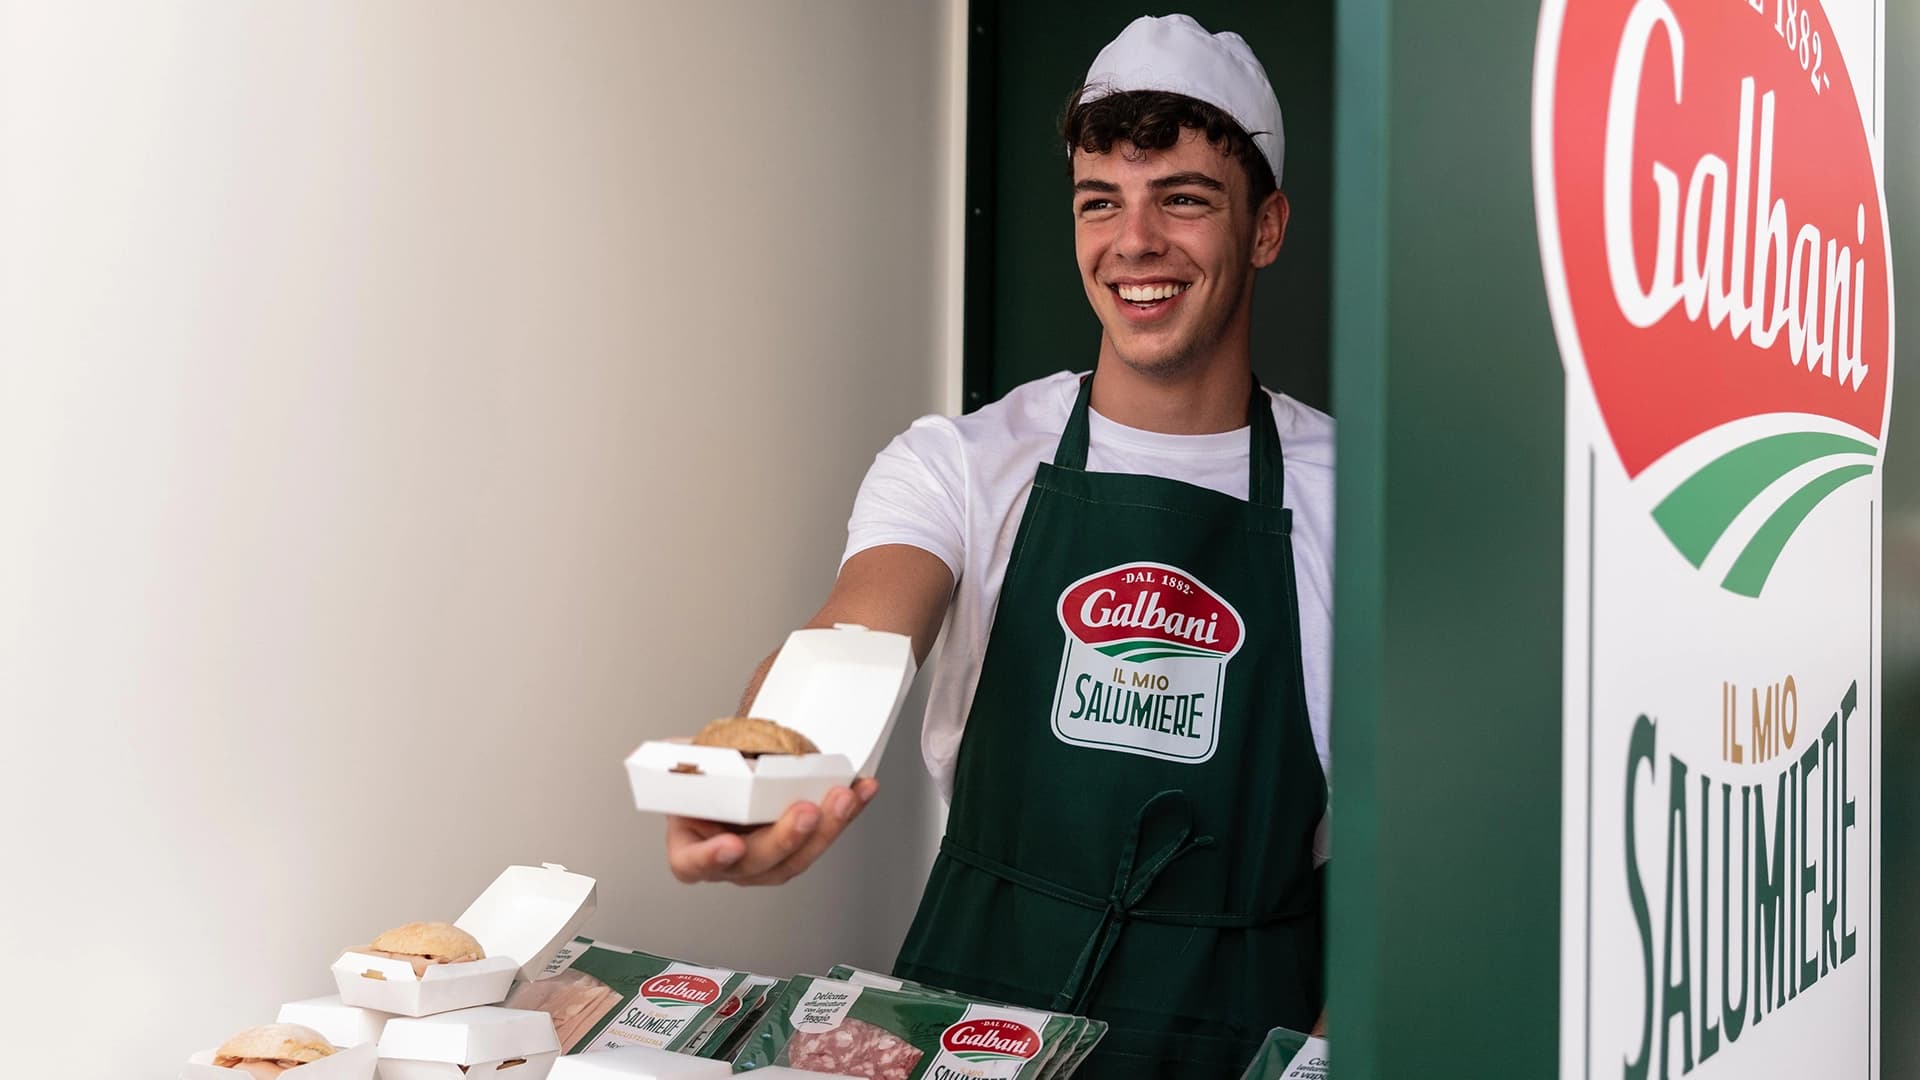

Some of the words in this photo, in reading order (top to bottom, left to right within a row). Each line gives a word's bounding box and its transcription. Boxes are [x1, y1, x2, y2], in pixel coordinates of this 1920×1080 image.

[1603, 0, 1868, 392] Galbani
[1080, 588, 1219, 644] Galbani
[1069, 672, 1205, 739] SALUMIERE
[1113, 667, 1126, 685] IL
[1132, 671, 1169, 691] MIO
[1722, 680, 1743, 765] IL
[1751, 674, 1798, 765] MIO
[1623, 679, 1857, 1080] SALUMIERE
[648, 977, 713, 1001] Galbani
[619, 1007, 685, 1037] SALUMIERE
[951, 1026, 1032, 1054] Galbani
